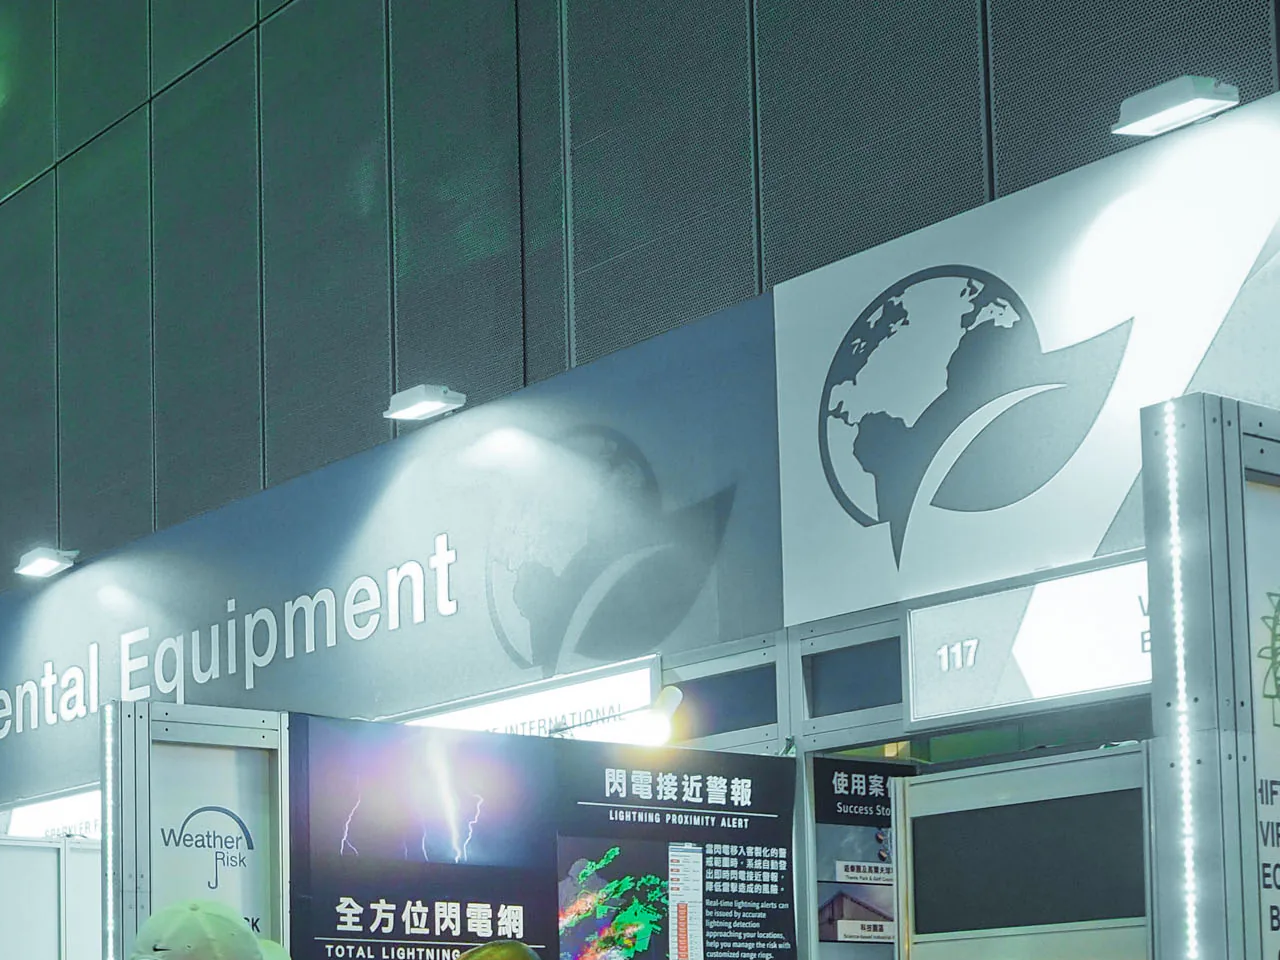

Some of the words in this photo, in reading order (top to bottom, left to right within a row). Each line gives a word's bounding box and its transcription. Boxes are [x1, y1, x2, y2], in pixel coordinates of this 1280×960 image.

[120, 533, 458, 704] Equipment
[937, 638, 979, 672] 117
[605, 768, 752, 806] 閃電接近警報
[836, 802, 874, 815] Success
[666, 814, 715, 827] PROXIMITY
[721, 818, 749, 829] ALERT
[161, 828, 242, 850] Weather
[212, 851, 247, 876] Risk
[335, 897, 524, 938] 全方位閃電網
[714, 909, 733, 917] issued
[733, 910, 741, 919] by
[733, 920, 760, 928] detection
[743, 932, 756, 940] your
[325, 945, 374, 958] TOTAL
[382, 947, 461, 960] LIGHTNING
[706, 940, 719, 949] help
[720, 942, 731, 950] you
[732, 942, 755, 950] manage
[767, 941, 777, 949] risk
[740, 952, 757, 960] range
